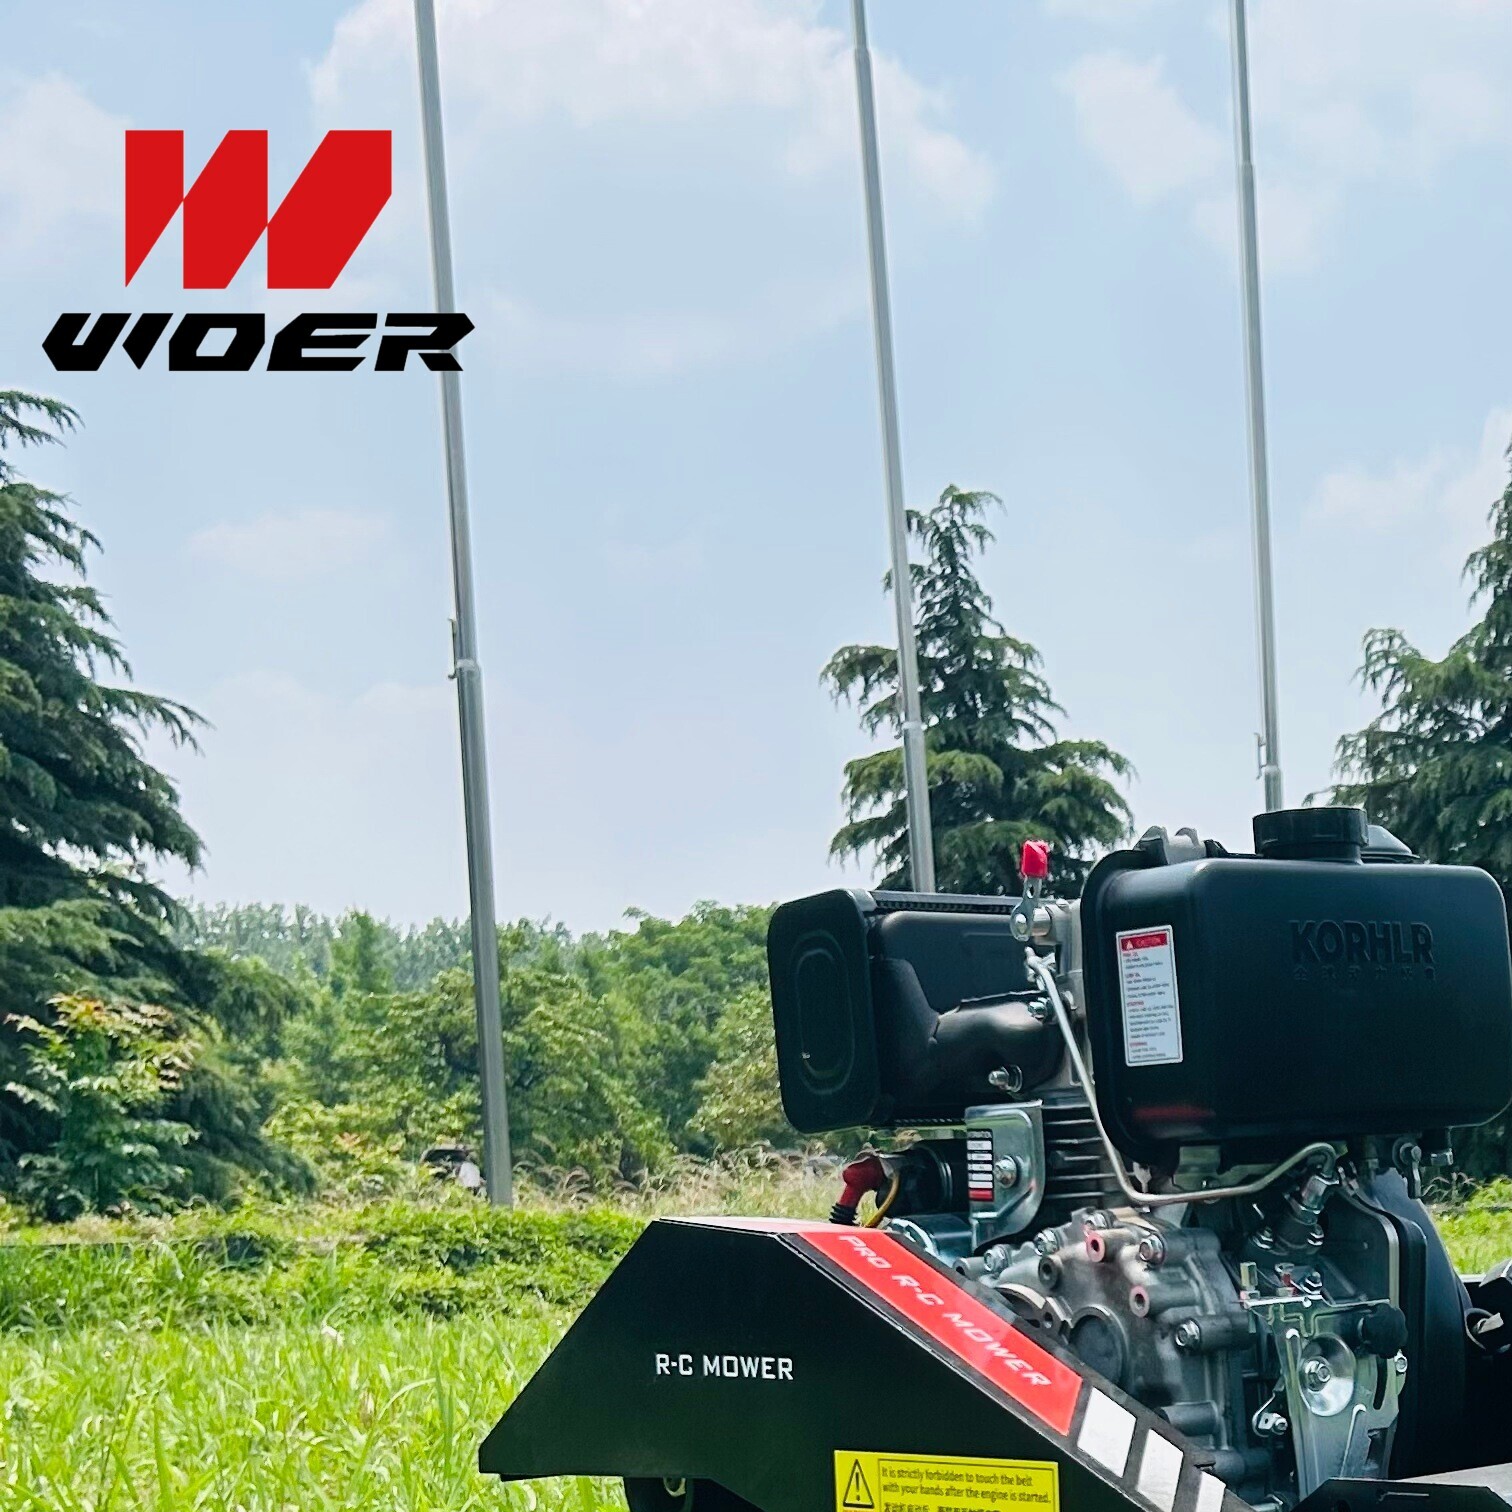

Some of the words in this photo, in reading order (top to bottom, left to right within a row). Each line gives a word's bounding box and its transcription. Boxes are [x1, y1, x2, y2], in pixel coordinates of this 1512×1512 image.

[1289, 920, 1436, 963] KORHLR
[837, 1235, 892, 1269] PRO
[891, 1274, 945, 1306] R-C
[942, 1312, 1052, 1386] MOWER
[655, 1353, 693, 1376] R-C
[702, 1354, 794, 1380] MOWER
[889, 1467, 896, 1478] is
[897, 1468, 924, 1482] strictly
[925, 1468, 964, 1482] forbidden
[966, 1473, 974, 1483] to
[976, 1473, 999, 1484] touch
[1001, 1474, 1015, 1485] the
[1016, 1474, 1033, 1486] belt
[883, 1482, 899, 1492] with
[901, 1485, 919, 1496] your
[920, 1484, 944, 1496] hands
[945, 1486, 964, 1497] after
[966, 1487, 979, 1498] the
[981, 1488, 1008, 1503] engine
[1010, 1489, 1017, 1501] is
